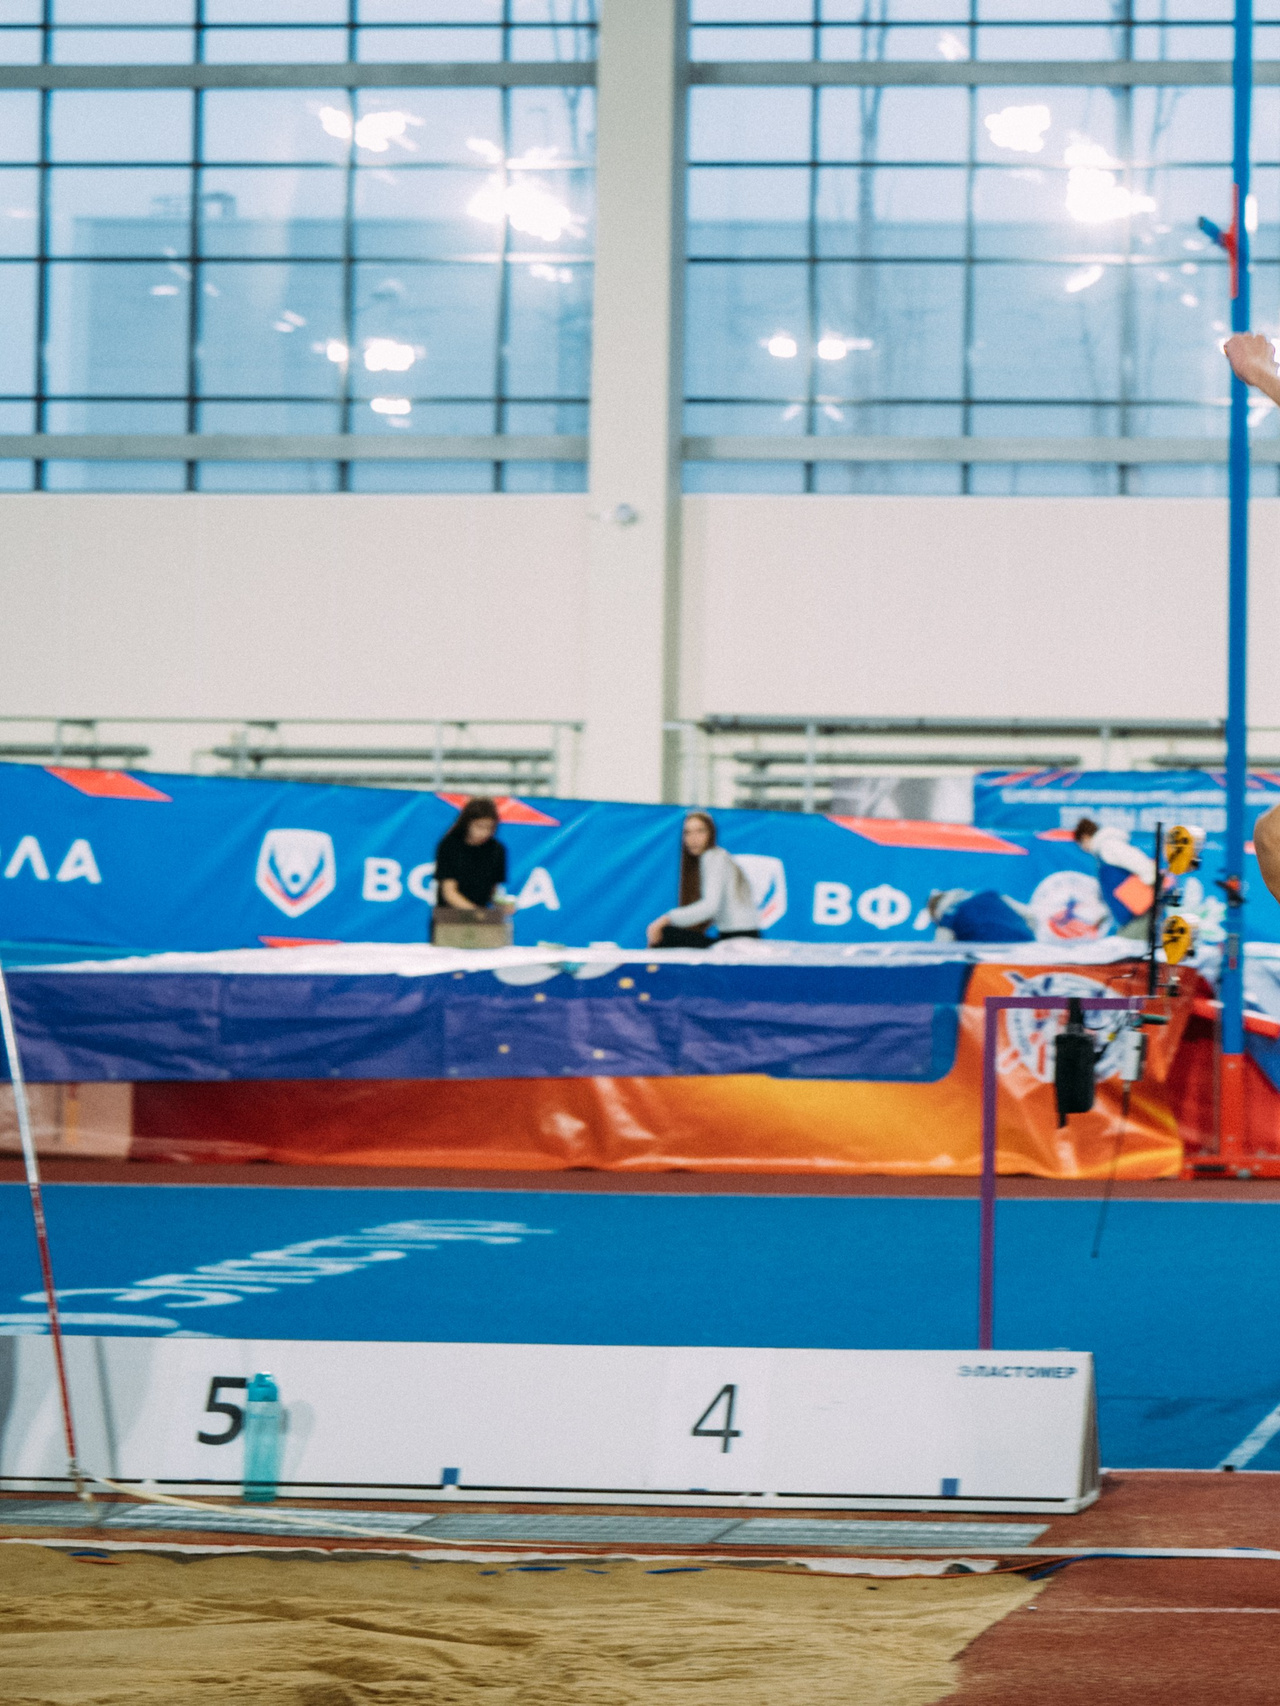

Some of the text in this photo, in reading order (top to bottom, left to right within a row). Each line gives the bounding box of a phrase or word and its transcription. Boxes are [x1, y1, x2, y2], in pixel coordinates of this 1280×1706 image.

[0, 835, 102, 884] ЛА
[196, 1376, 249, 1446] 5
[690, 1383, 742, 1454] 4
